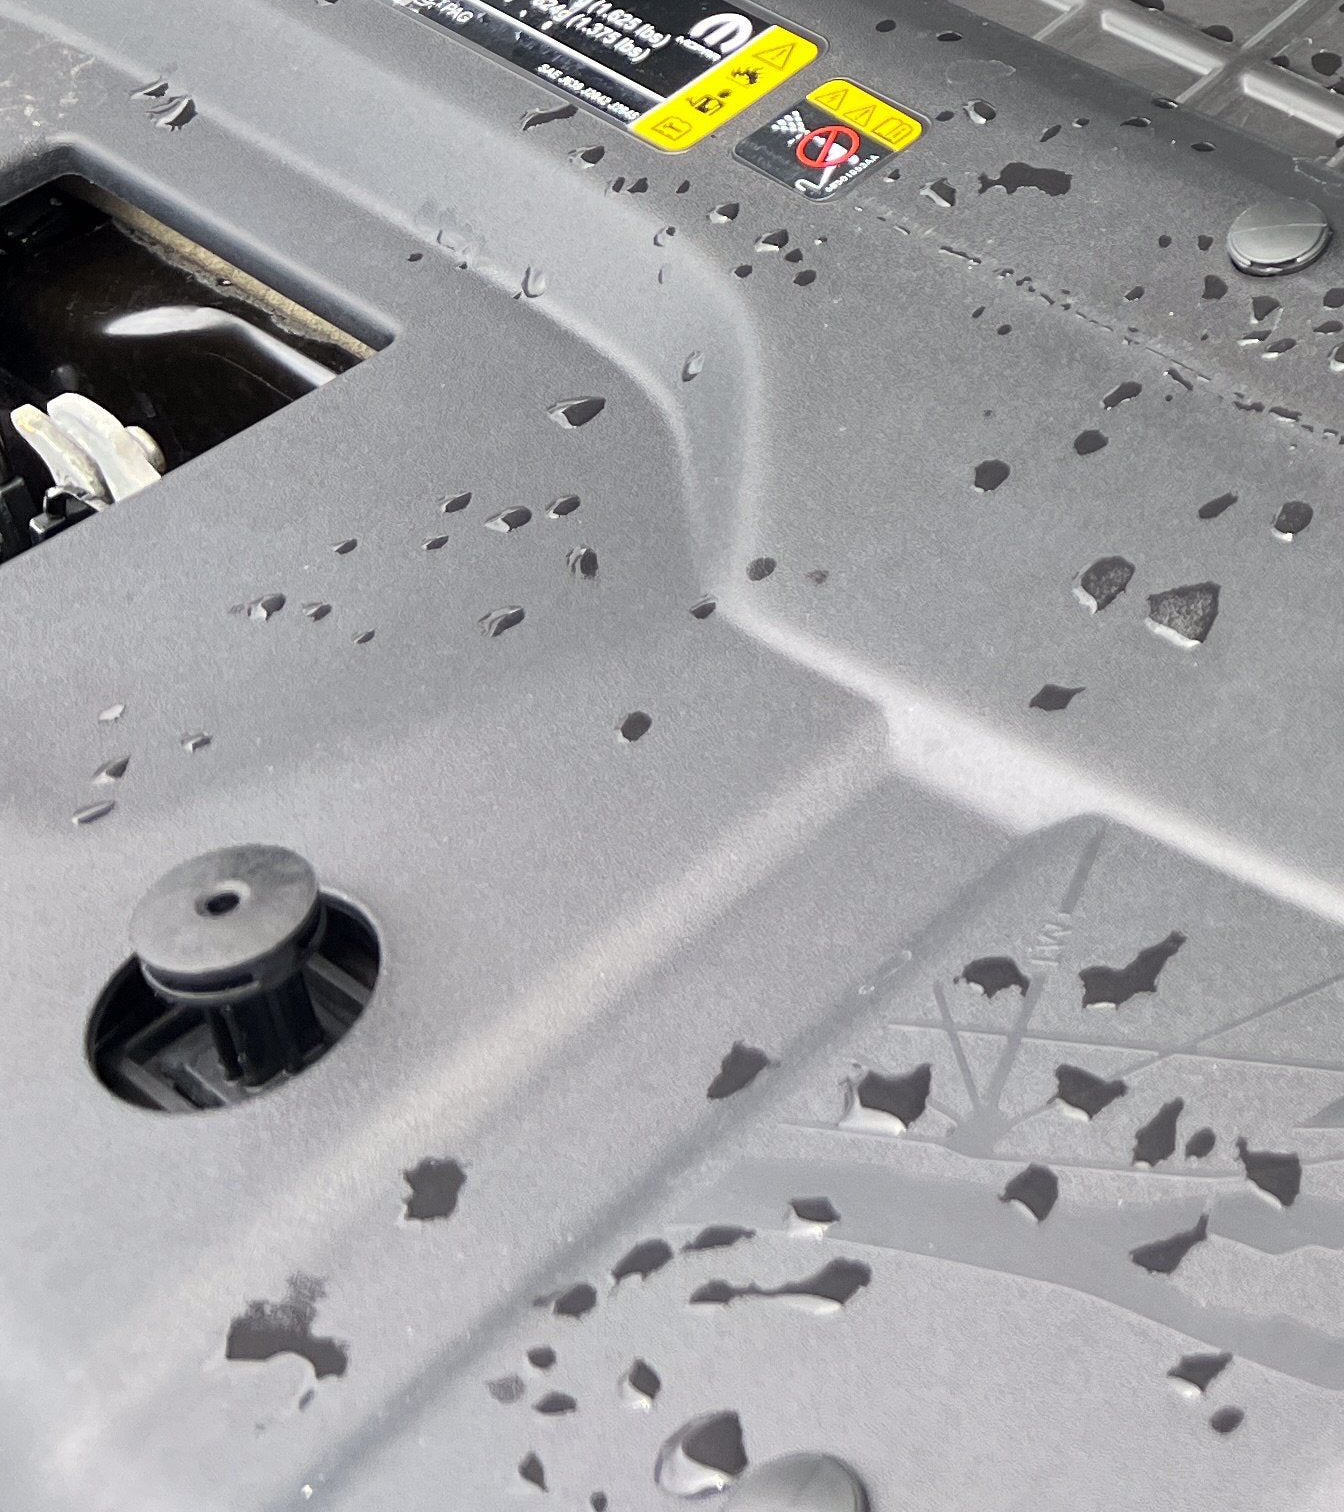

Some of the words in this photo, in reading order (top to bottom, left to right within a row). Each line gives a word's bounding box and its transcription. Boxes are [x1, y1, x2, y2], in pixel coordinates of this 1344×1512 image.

[565, 13, 622, 45] (1.375
[614, 37, 651, 64] lbs)
[587, 0, 642, 33] (1.625
[634, 23, 671, 49] lbs)
[537, 63, 563, 80] SAE
